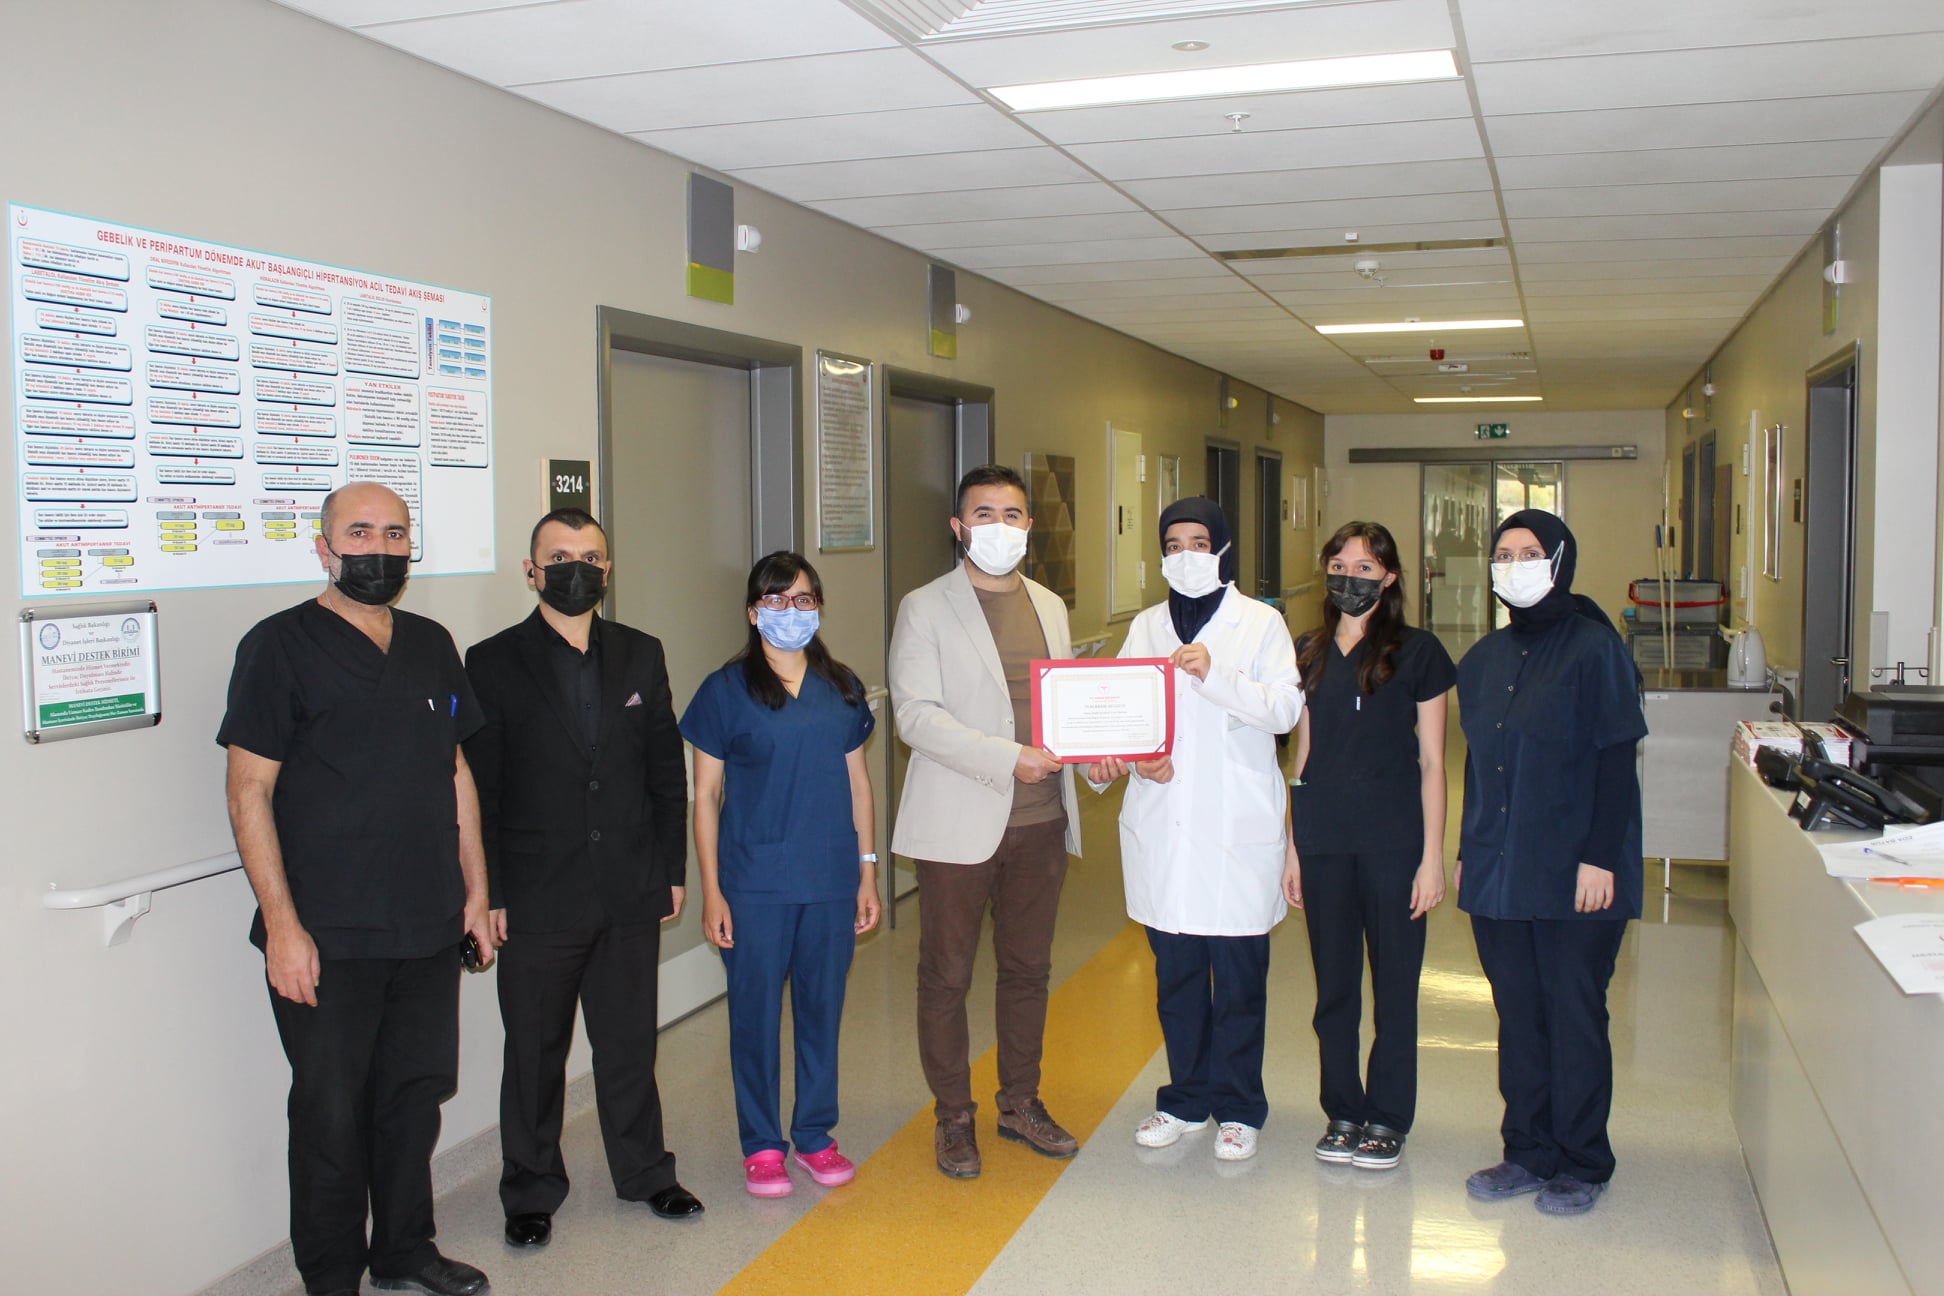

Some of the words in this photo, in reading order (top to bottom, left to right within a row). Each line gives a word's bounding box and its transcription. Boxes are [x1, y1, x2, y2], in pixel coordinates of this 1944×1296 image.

[97, 230, 134, 246] GEBELİK
[136, 236, 147, 248] VE
[150, 239, 202, 259] PERİPARTUM
[205, 250, 243, 266] DÖNEMDE
[246, 258, 266, 270] AKUT
[268, 262, 314, 280] BAŞLANGIÇLI
[370, 281, 384, 292] ACİL
[424, 291, 445, 303] ŞEMASI
[556, 475, 583, 493] 3214
[41, 651, 76, 665] MANEVİ
[79, 650, 111, 662] DESTEK
